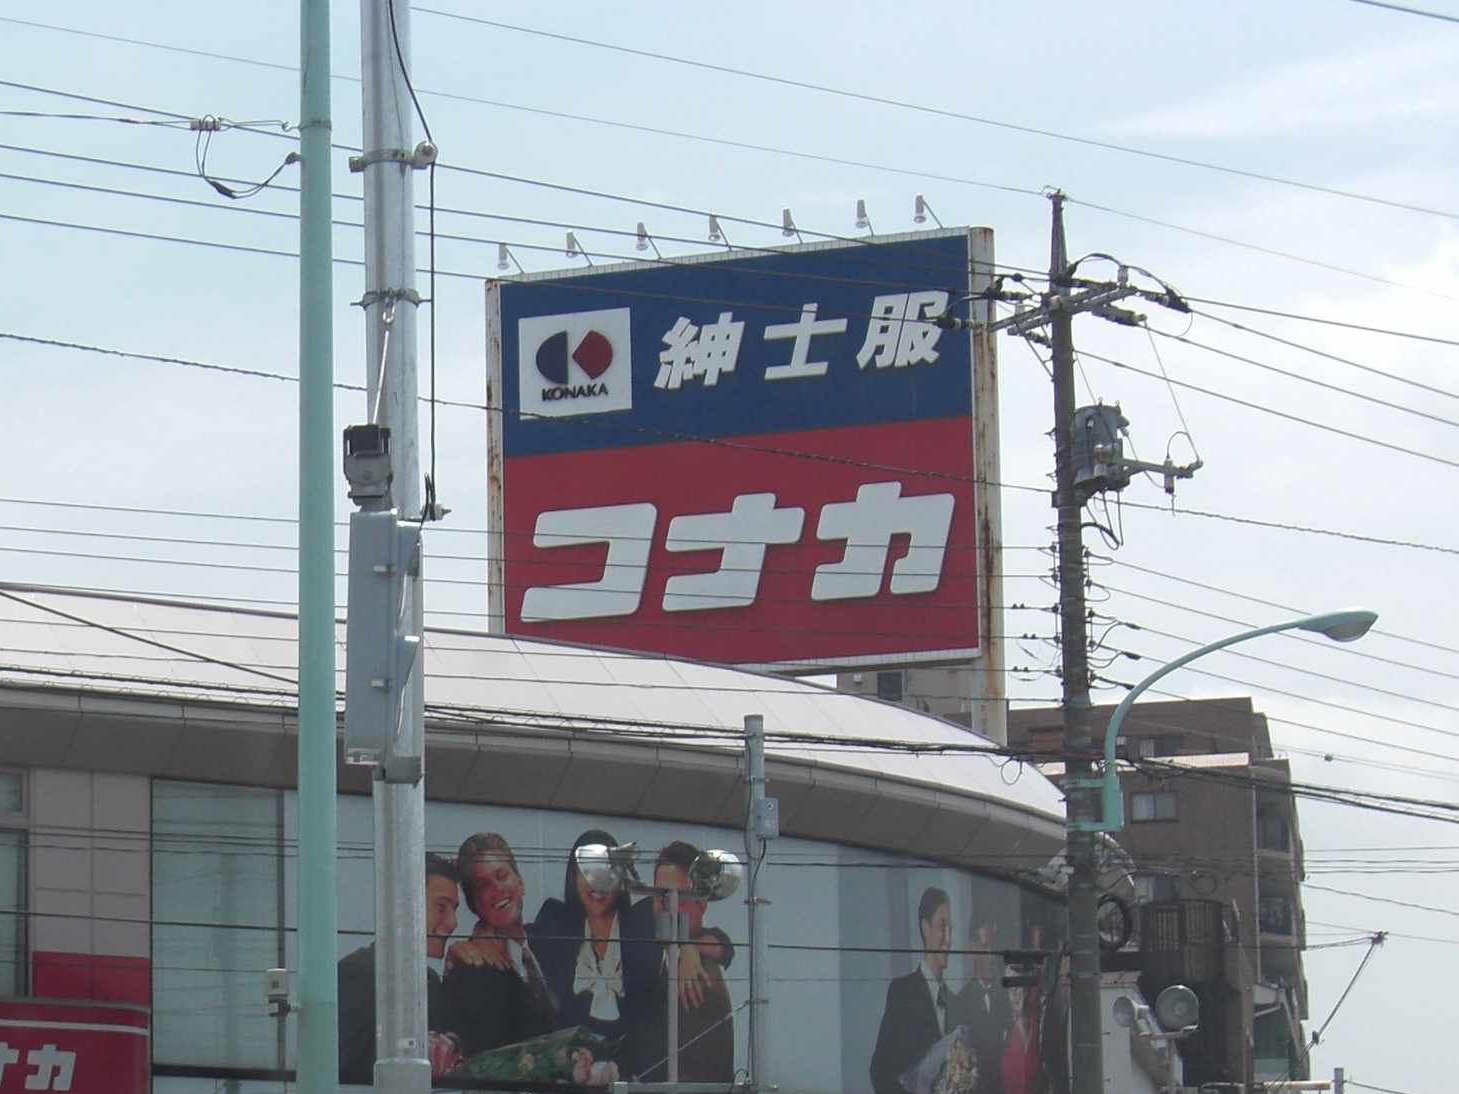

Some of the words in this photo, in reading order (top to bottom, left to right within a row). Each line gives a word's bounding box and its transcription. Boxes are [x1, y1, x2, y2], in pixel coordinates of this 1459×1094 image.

[653, 289, 950, 391] 紳士服
[542, 382, 609, 402] KONAKA
[520, 481, 955, 623] コナカ
